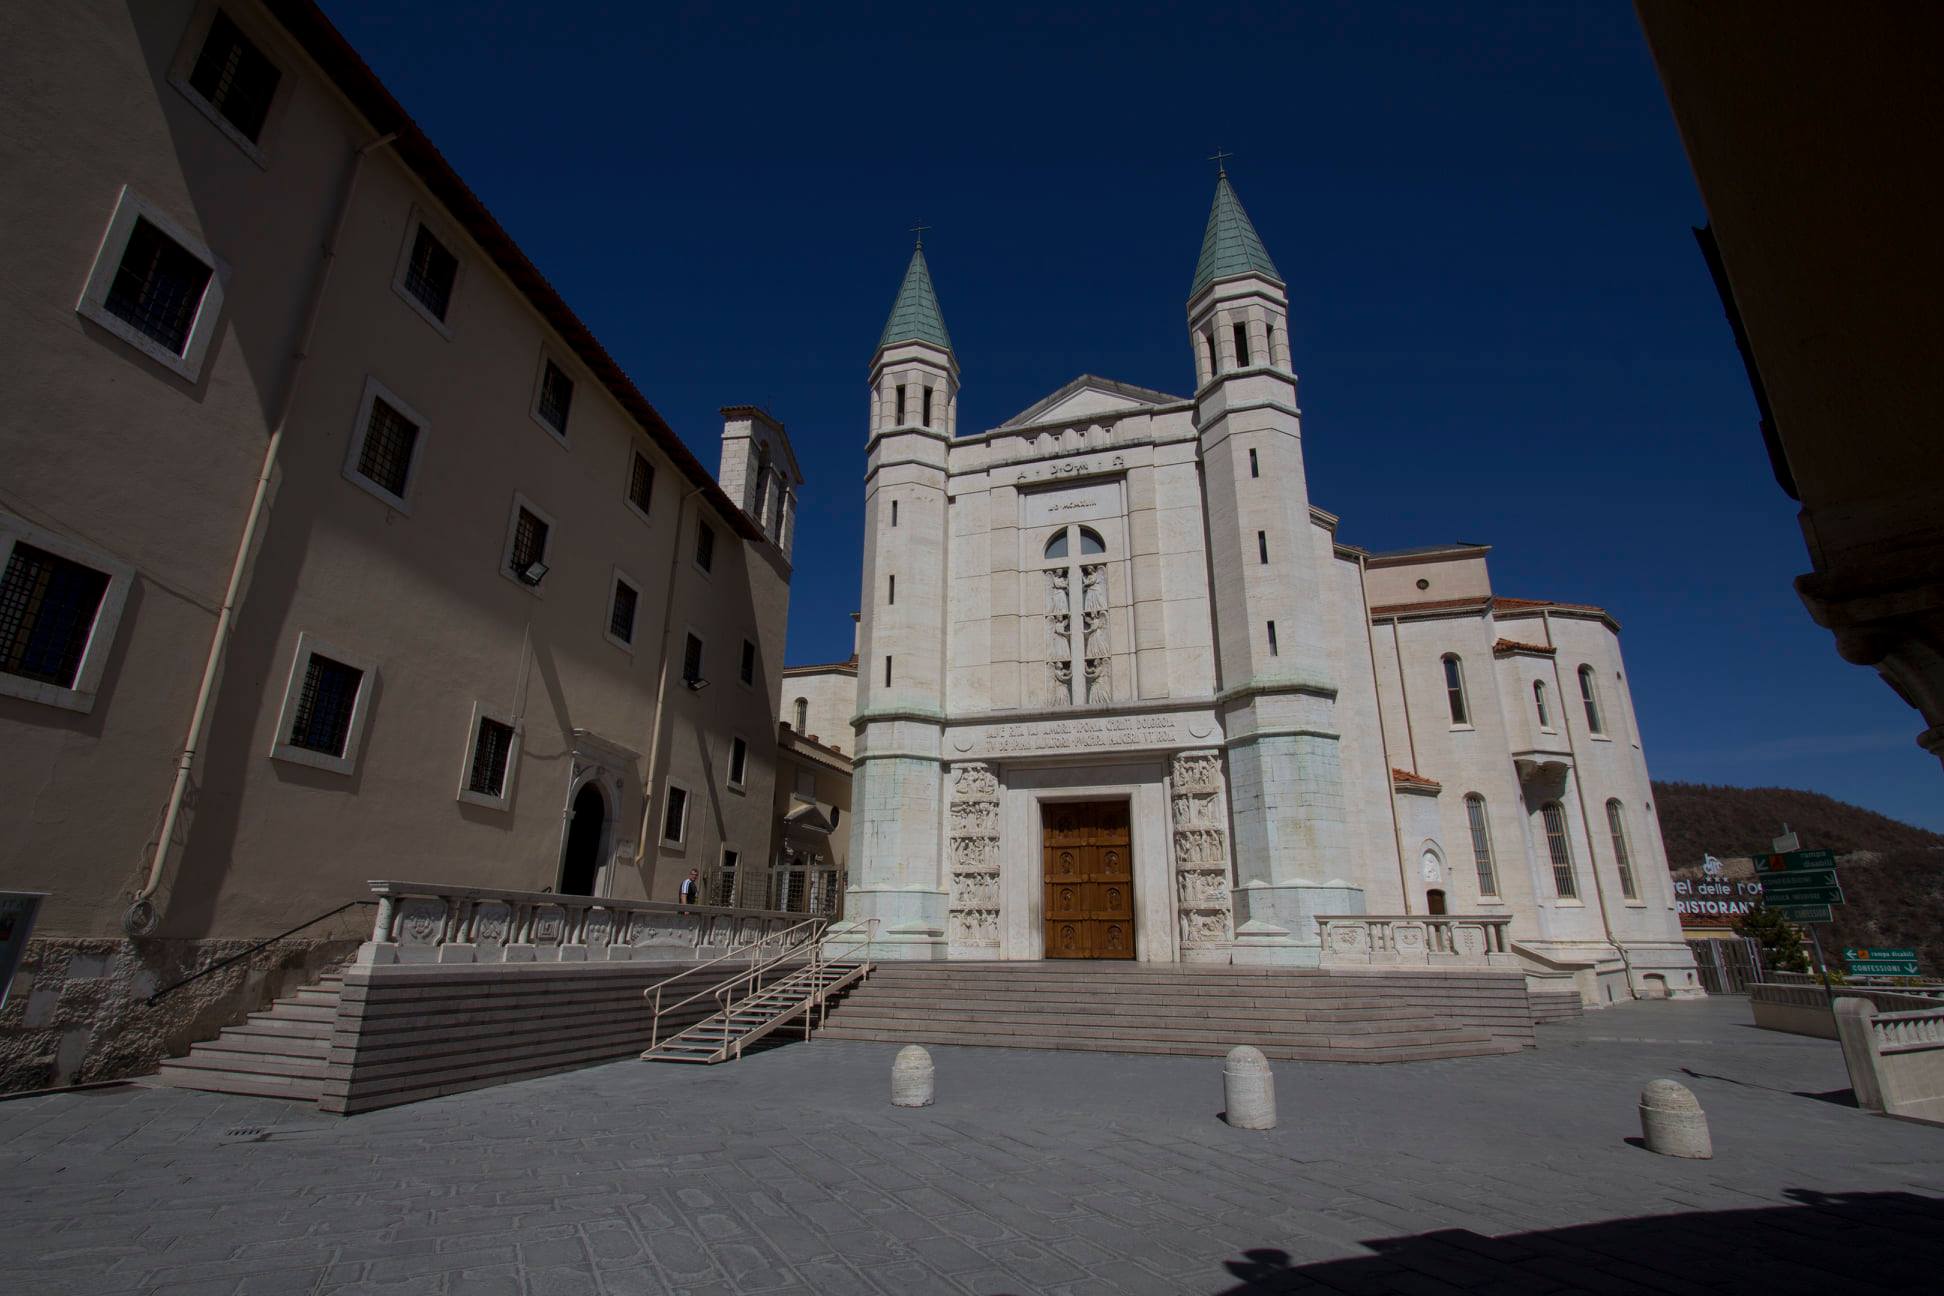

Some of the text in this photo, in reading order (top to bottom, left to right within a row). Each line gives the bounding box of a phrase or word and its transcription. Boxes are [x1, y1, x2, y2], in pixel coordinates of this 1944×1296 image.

[1673, 879, 1692, 894] el
[1697, 883, 1731, 895] delle
[1676, 901, 1766, 914] RISTORAN
[1851, 964, 1902, 972] CONFESSIONI
